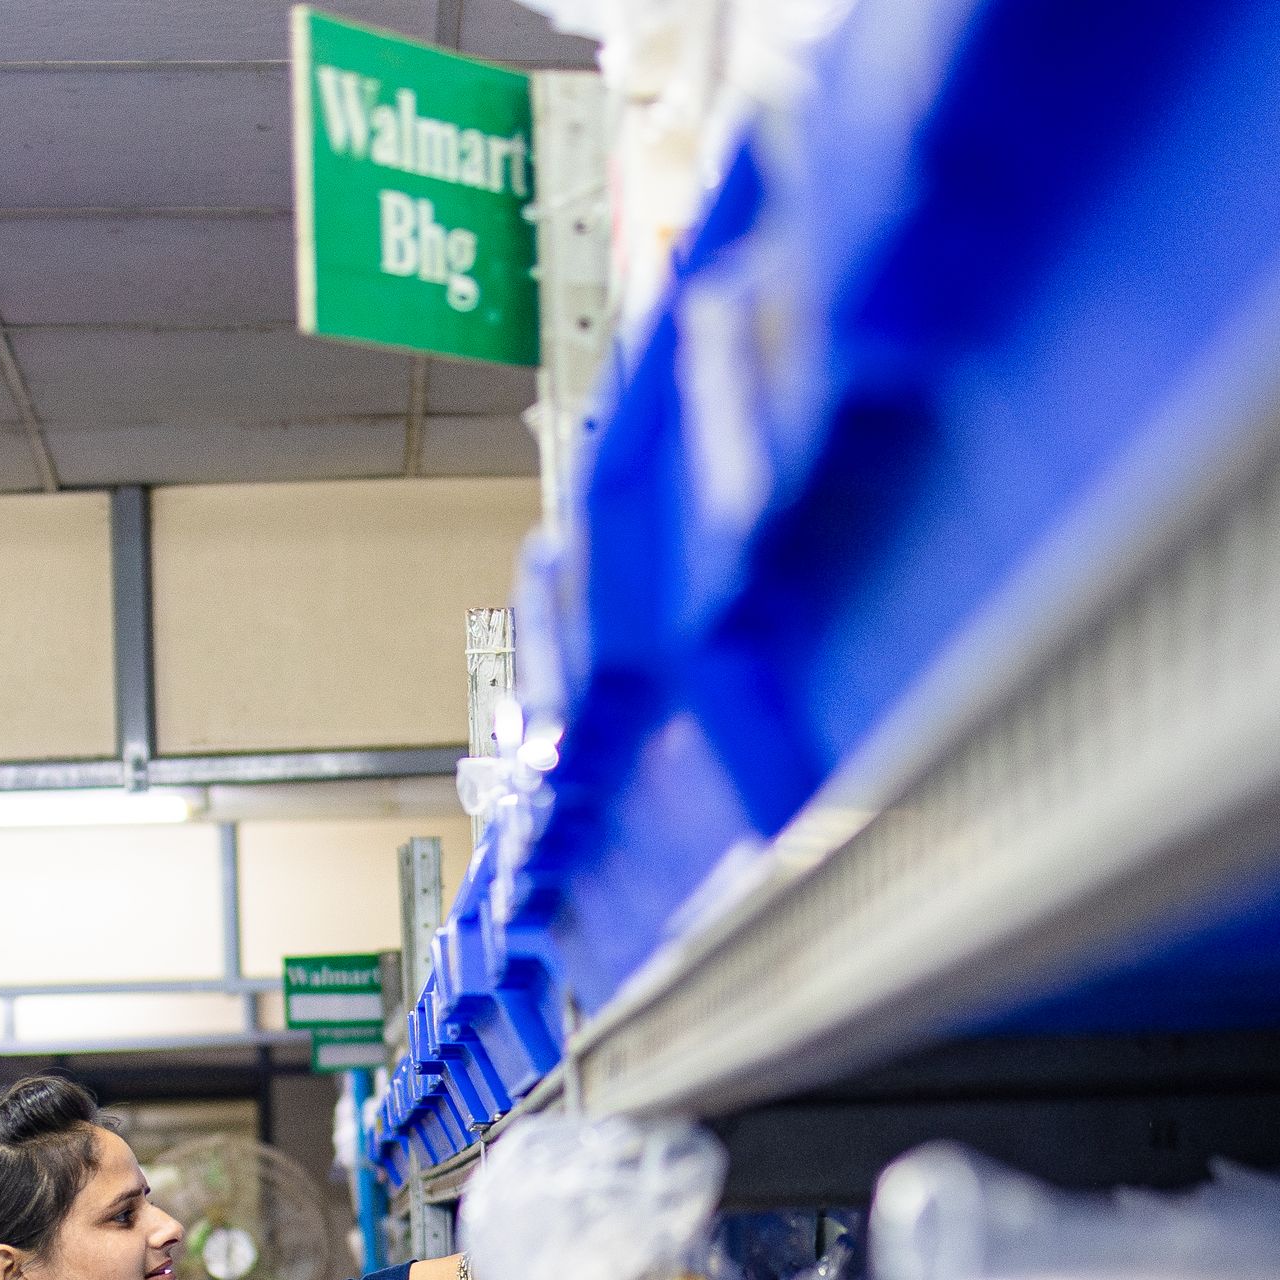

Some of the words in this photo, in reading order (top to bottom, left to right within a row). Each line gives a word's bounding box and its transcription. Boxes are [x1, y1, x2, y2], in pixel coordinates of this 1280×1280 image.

[317, 65, 531, 197] Walmart
[378, 189, 480, 313] Bhg
[287, 966, 382, 986] Walmart
